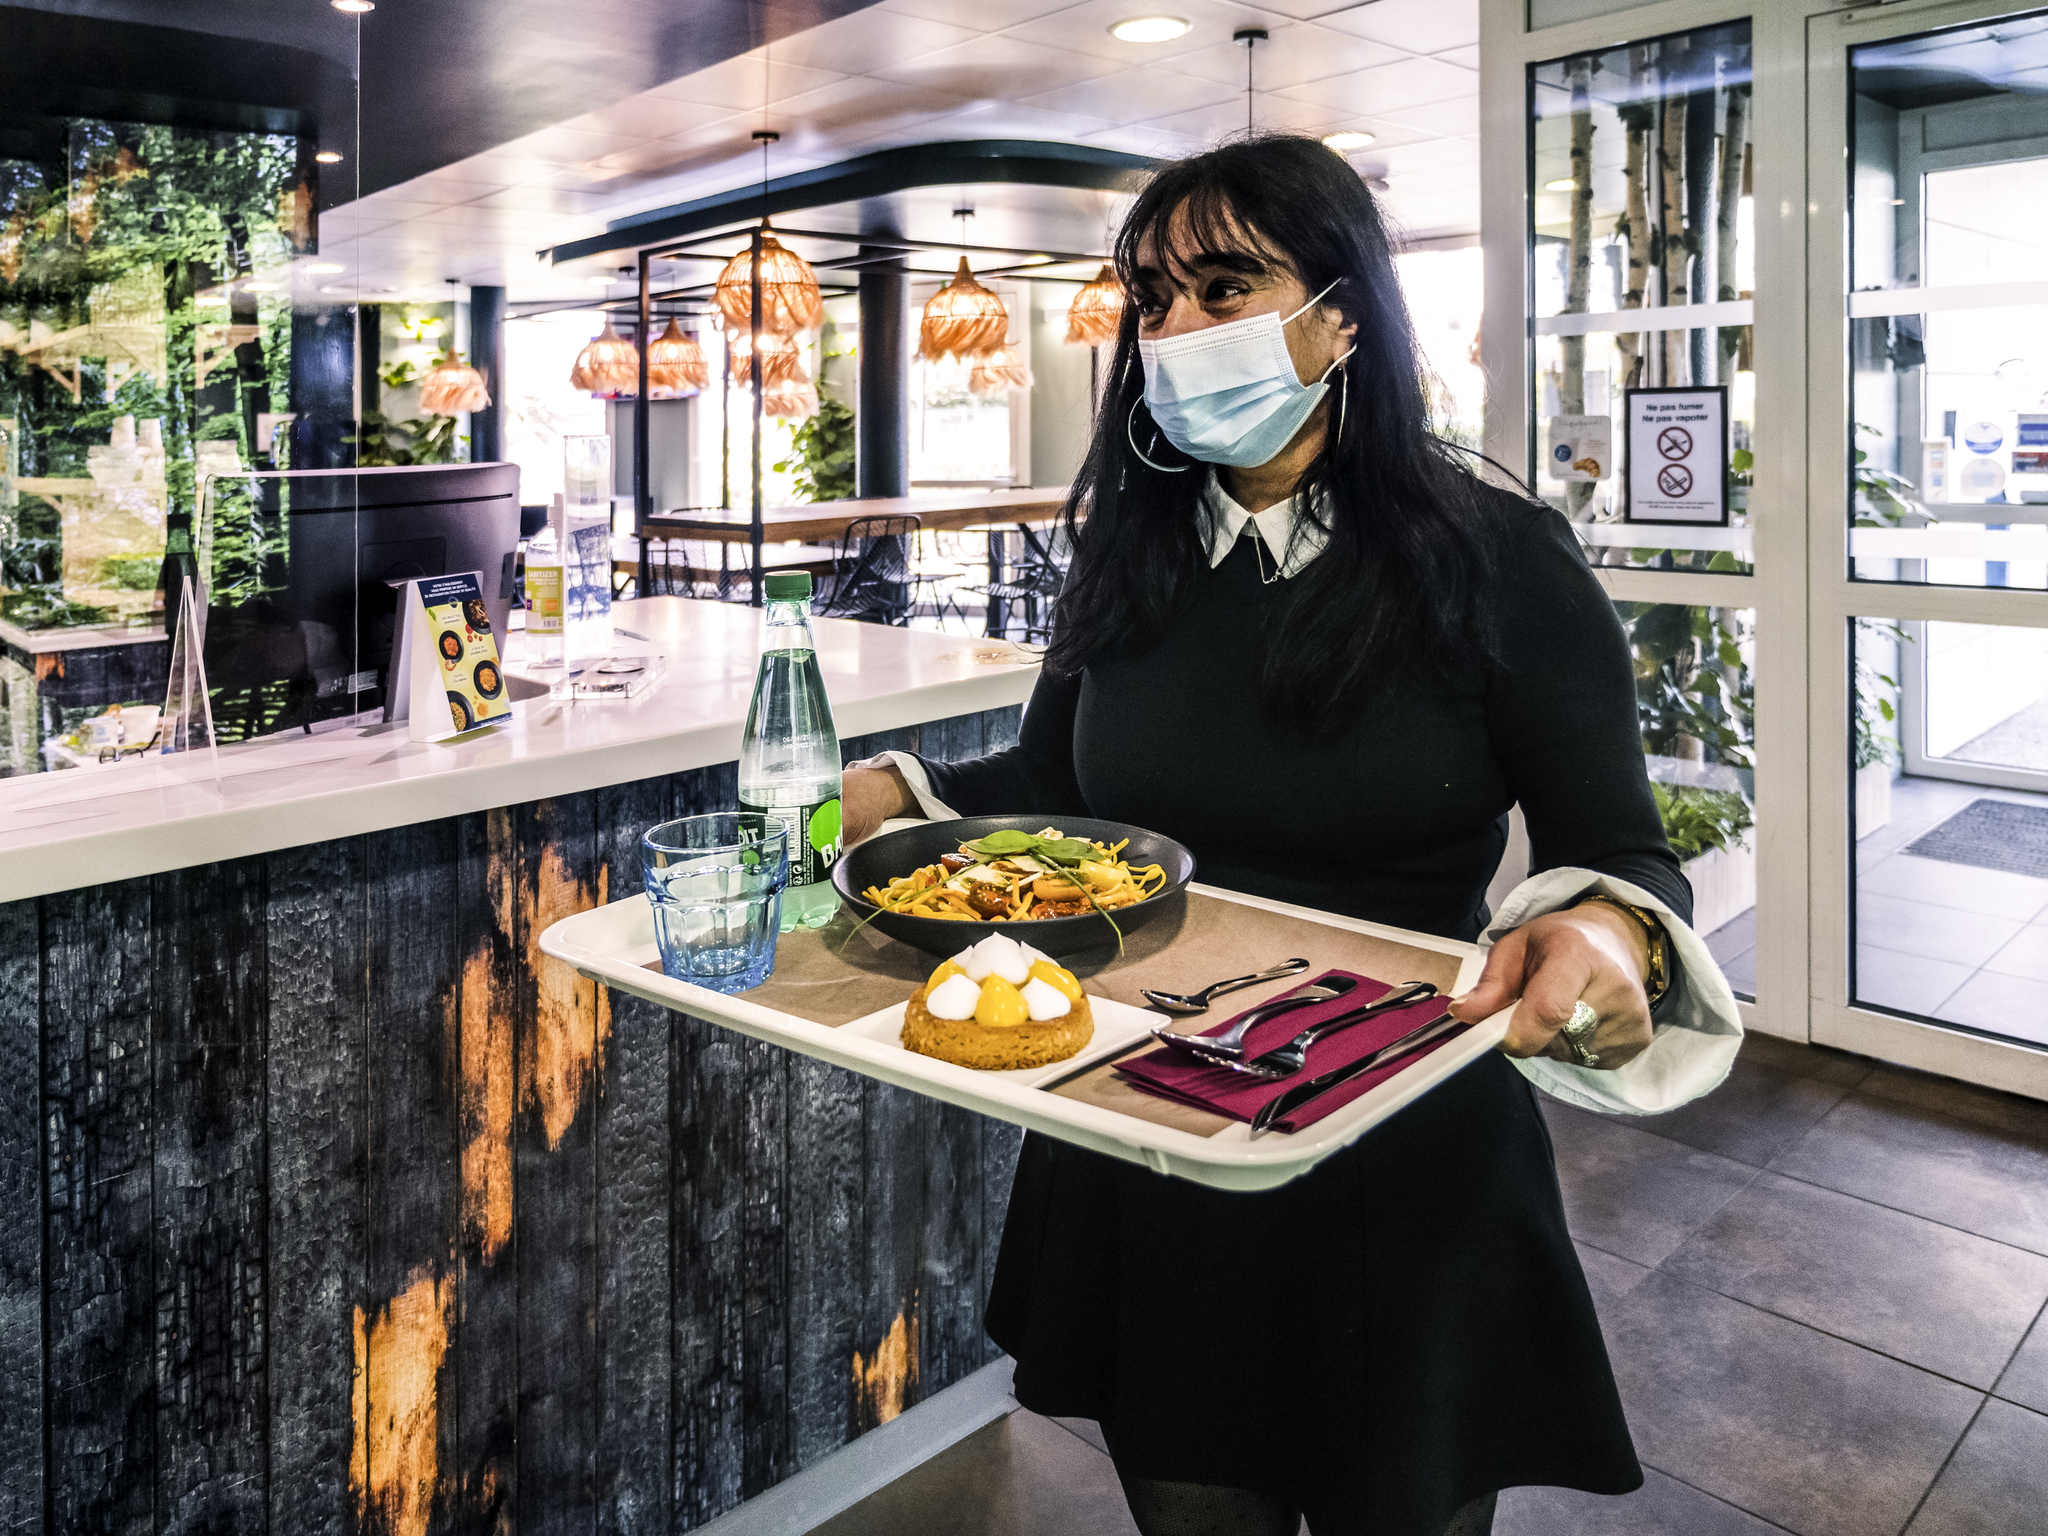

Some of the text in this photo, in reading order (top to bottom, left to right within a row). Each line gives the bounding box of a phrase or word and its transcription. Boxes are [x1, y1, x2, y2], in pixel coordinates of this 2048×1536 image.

[1660, 404, 1676, 412] pas
[1656, 415, 1672, 423] pas
[1675, 413, 1709, 423] vapoter
